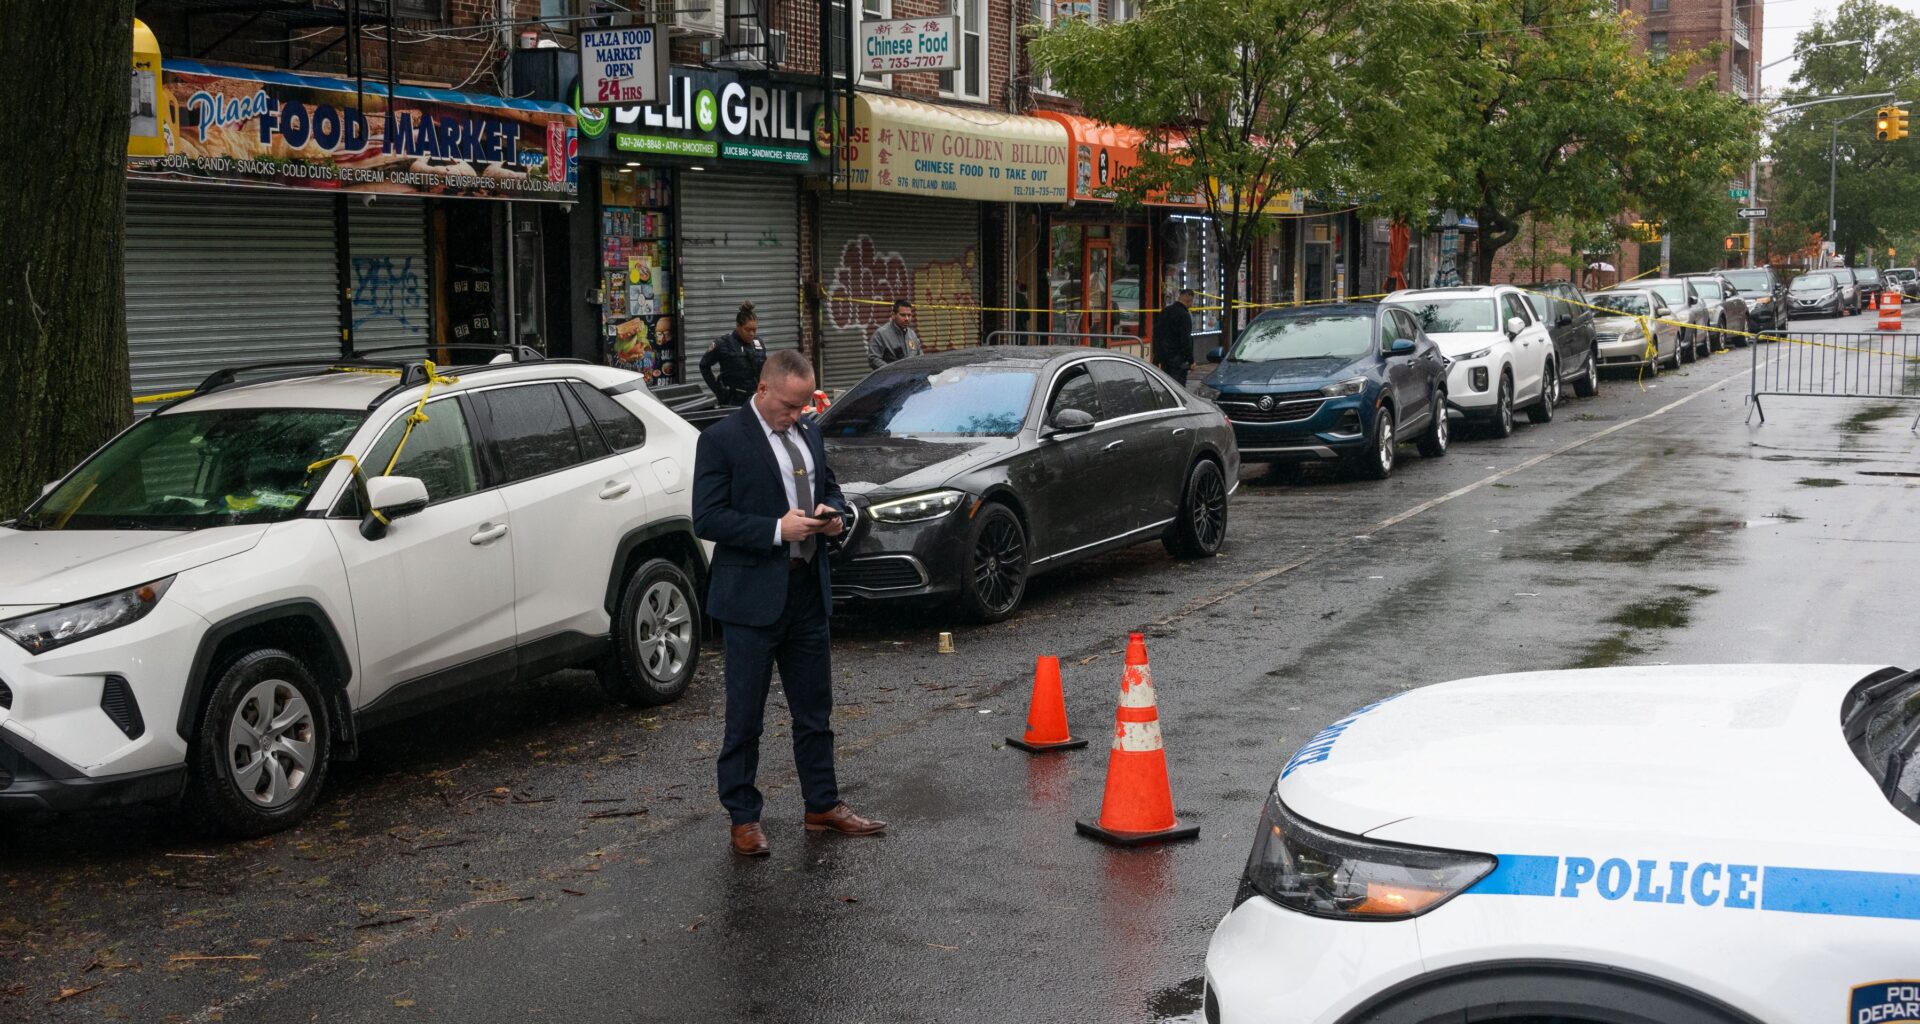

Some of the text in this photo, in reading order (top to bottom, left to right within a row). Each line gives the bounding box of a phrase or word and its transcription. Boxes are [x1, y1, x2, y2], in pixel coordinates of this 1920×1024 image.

[874, 21, 940, 35] 新金億
[584, 30, 651, 48] PLAZA FOOD
[866, 32, 948, 56] Chinese Food
[596, 47, 642, 62] MARKET
[888, 55, 944, 68] 735-7707
[605, 63, 633, 77] OPEN
[598, 78, 642, 101] 24 HRS
[187, 89, 270, 143] Plaza
[721, 82, 811, 141] GRILL
[259, 98, 370, 152] FOOD
[382, 111, 521, 166] MARKET
[666, 141, 678, 150] ATM
[682, 142, 714, 153] SMOOTHIES
[724, 146, 738, 156] JUICE
[739, 148, 749, 156] BAR
[752, 149, 782, 160] SANDWICHES
[898, 129, 1066, 165] NEW GOLDEN BILLION
[518, 152, 545, 166] CORP
[197, 156, 230, 172] CANDY
[237, 160, 275, 175] SNACKS
[282, 164, 306, 178] COLD
[308, 166, 332, 180] CUTS
[339, 168, 353, 181] ICE
[355, 169, 384, 183] CREAM
[390, 171, 440, 186] CIGARETTES
[445, 174, 495, 189] NEWSPAPERS
[500, 177, 515, 190] HOT
[516, 180, 522, 190] &
[522, 180, 541, 192] COLD
[543, 180, 577, 194] SANDWICH
[915, 159, 1048, 182] CHINESE FOOD TO TAKE OUT
[897, 176, 909, 188] 976
[912, 178, 938, 190] RUTLAND
[1560, 856, 1759, 909] POLICE
